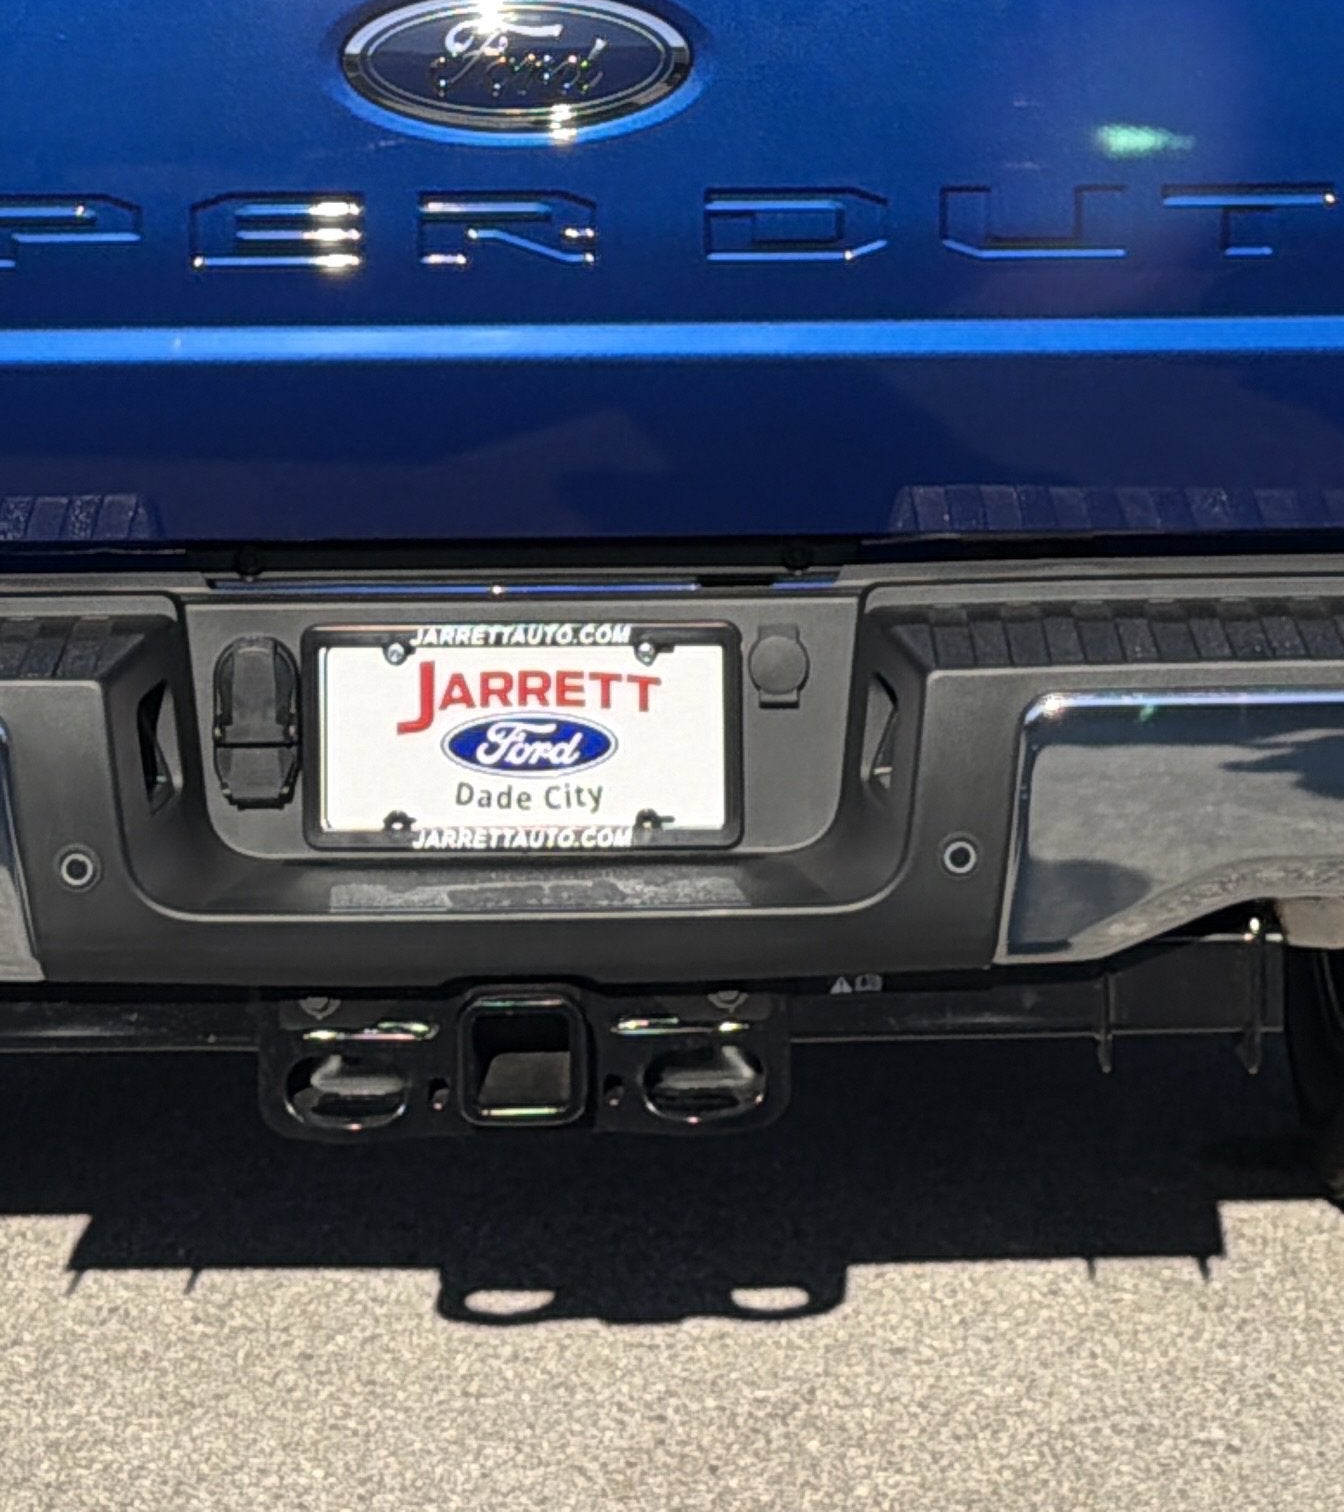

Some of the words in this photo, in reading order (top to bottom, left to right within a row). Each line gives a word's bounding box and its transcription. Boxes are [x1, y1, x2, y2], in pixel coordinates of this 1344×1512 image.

[430, 13, 609, 97] Ford
[410, 624, 632, 647] JARRETTAUTO.COM
[396, 660, 662, 735] JARRETT
[476, 720, 582, 767] Ford
[455, 782, 532, 810] Dade
[545, 783, 603, 813] City
[411, 827, 633, 850] JARRETTAUTO.COM
